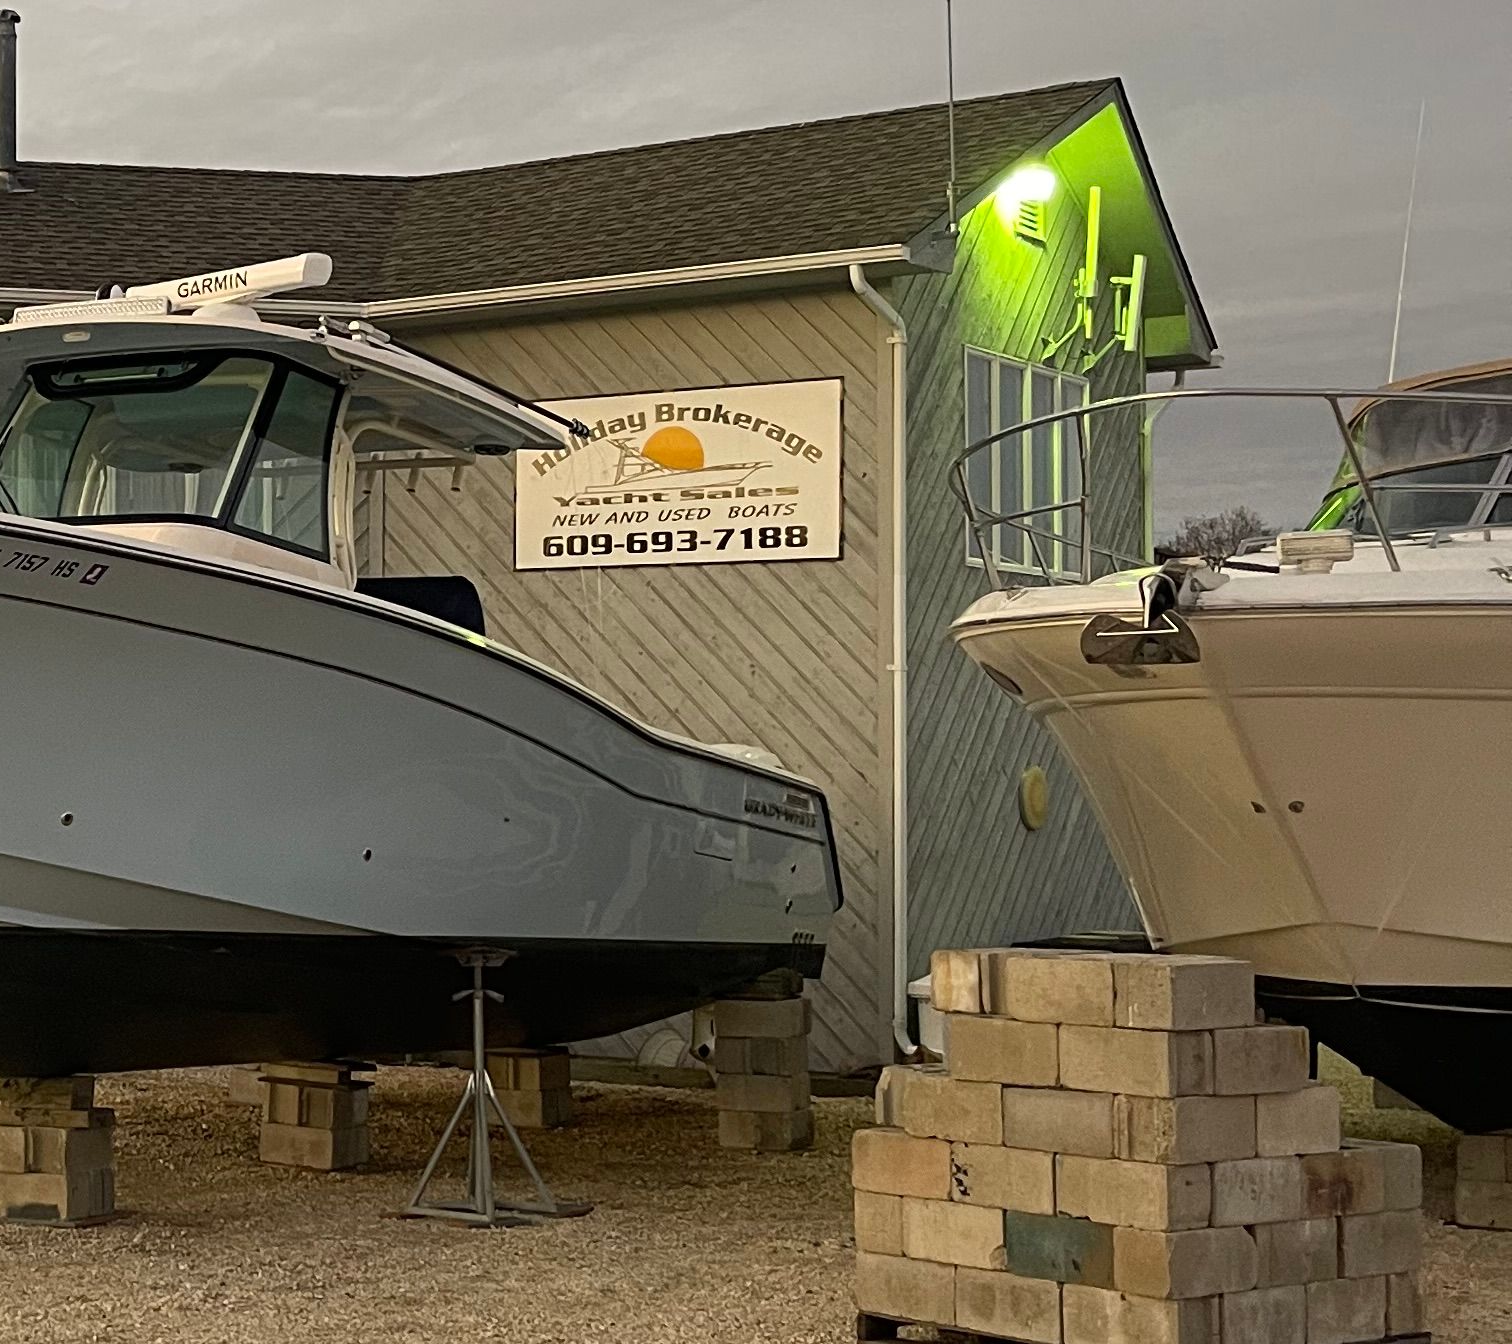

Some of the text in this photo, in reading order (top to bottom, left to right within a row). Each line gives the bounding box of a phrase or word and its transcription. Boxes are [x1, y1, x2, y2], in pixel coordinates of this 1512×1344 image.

[177, 270, 248, 298] GARMIN
[655, 403, 823, 464] Brokerage
[552, 486, 800, 507] Yacht Sales
[552, 502, 799, 527] NEW AND USED BOATS
[542, 525, 809, 557] 609-693-7188
[3, 551, 50, 573] 7157
[50, 559, 80, 578] HS
